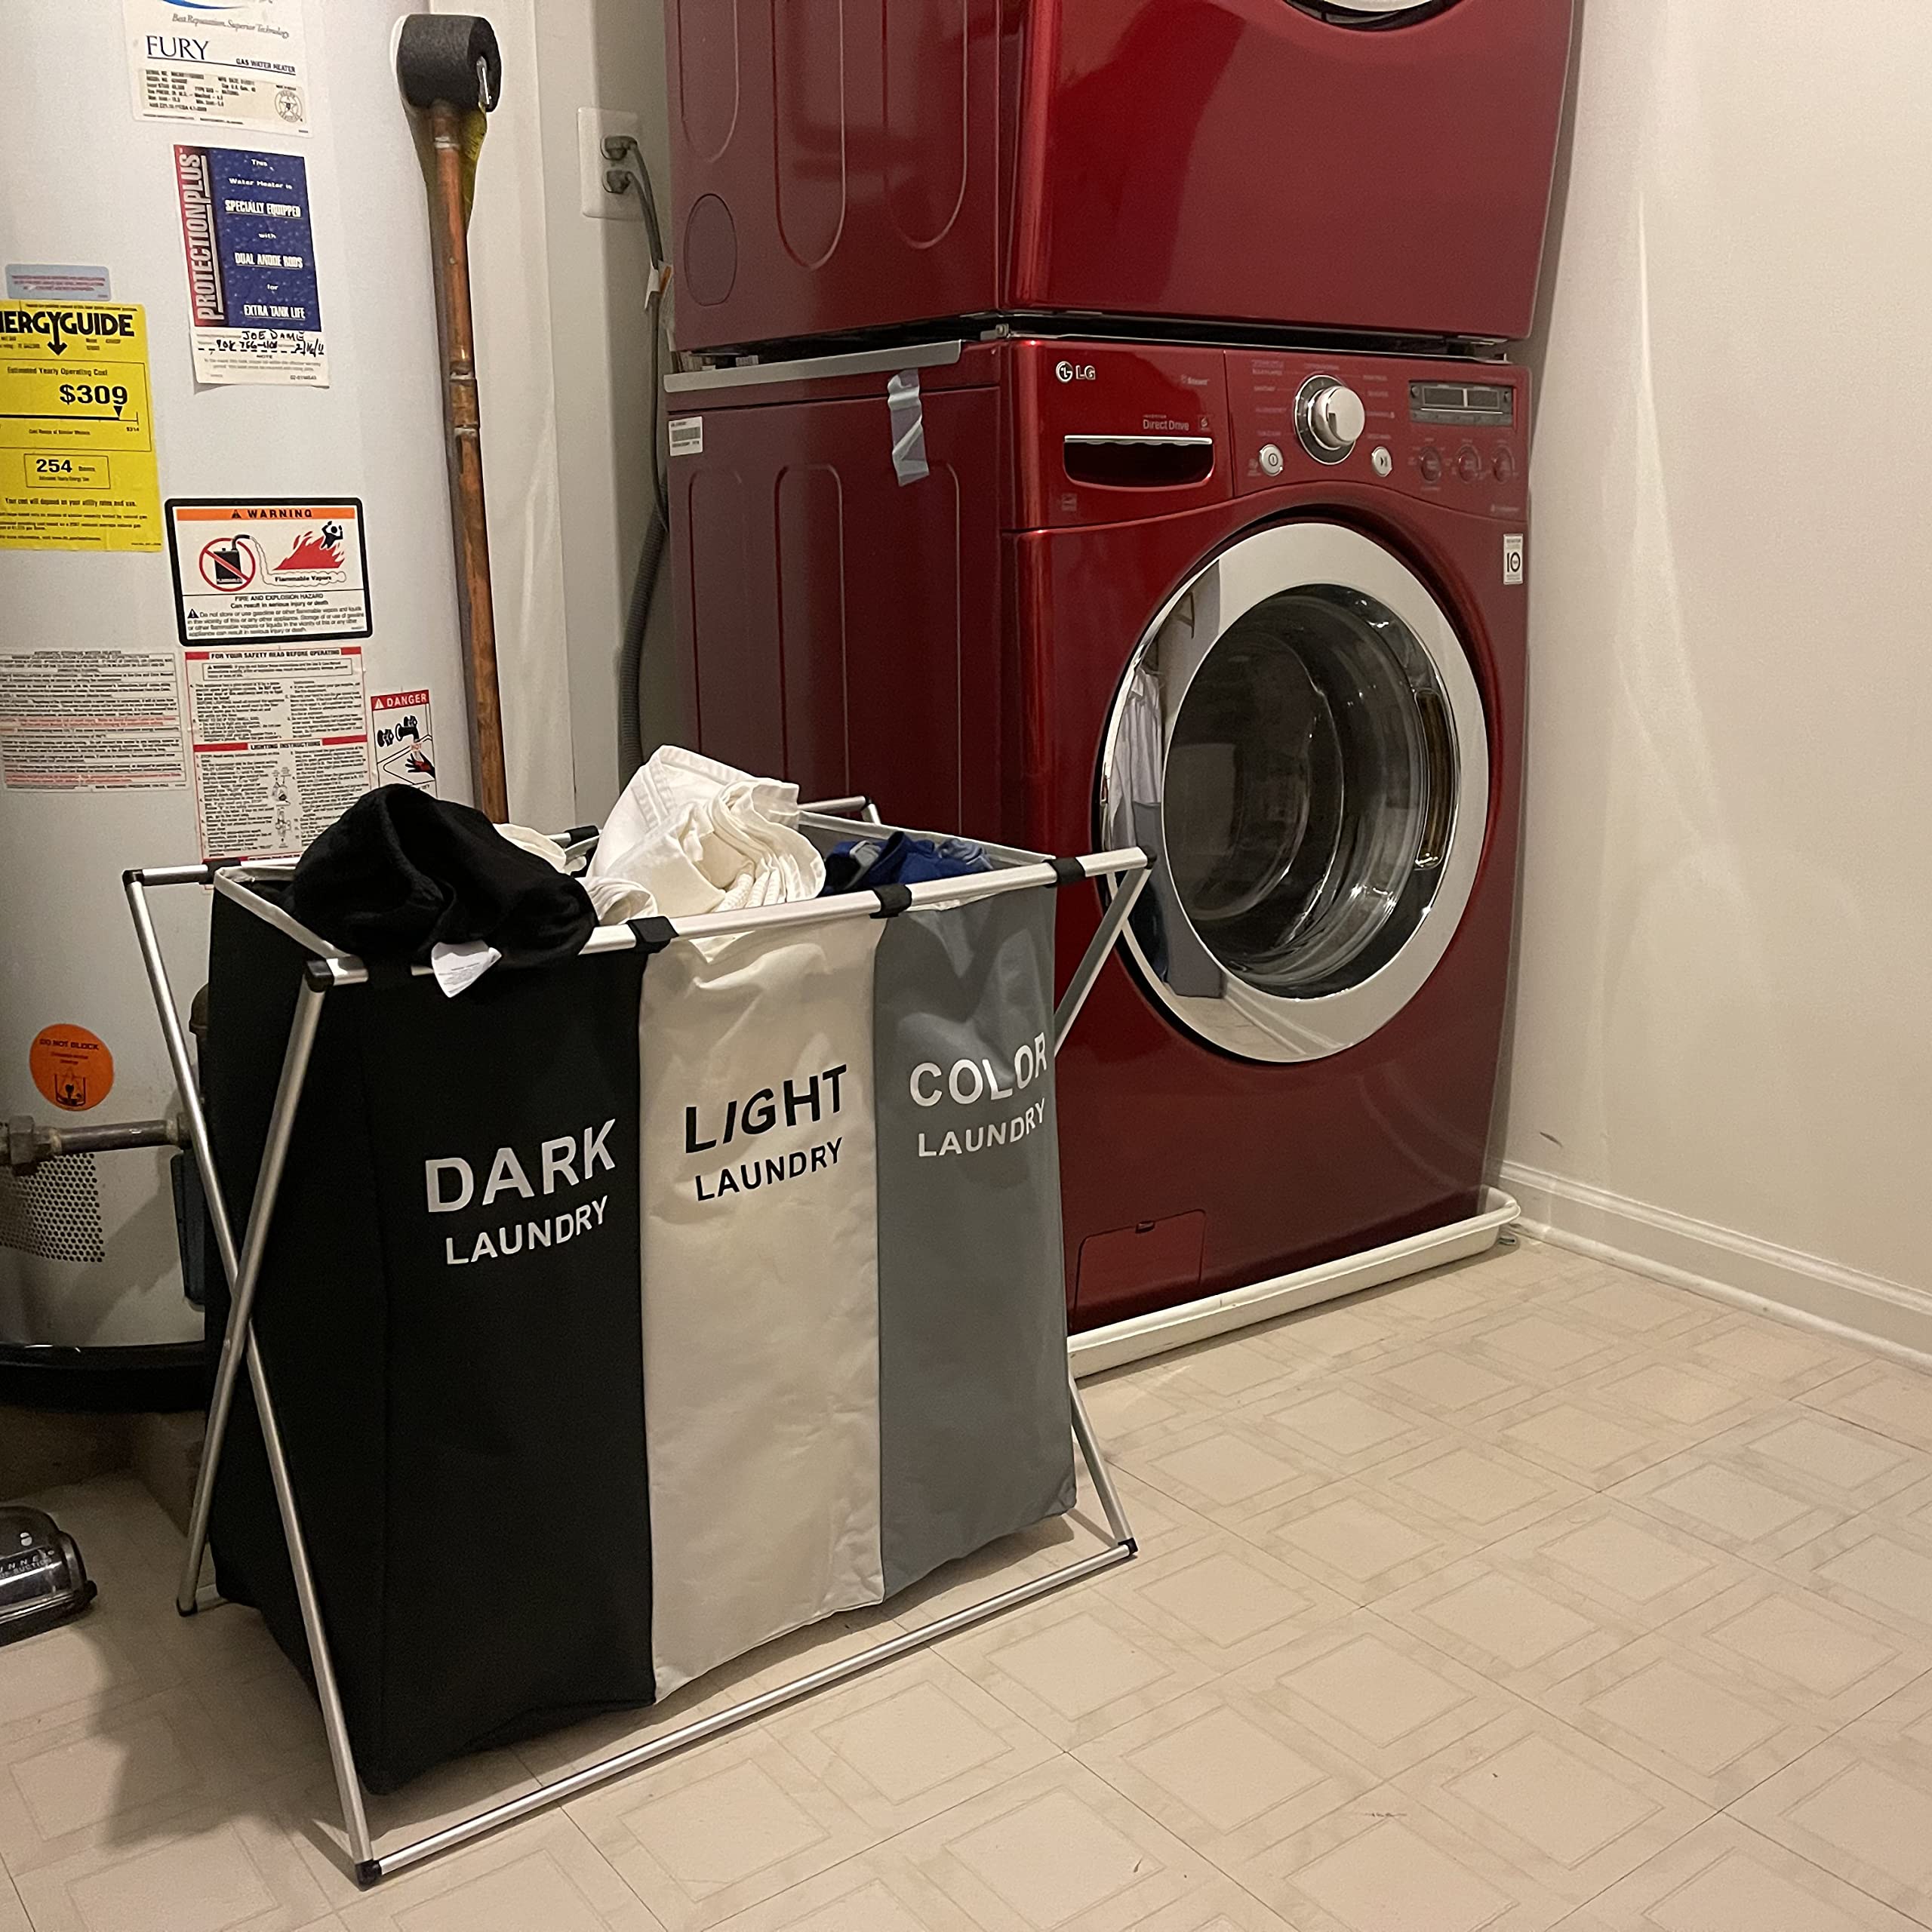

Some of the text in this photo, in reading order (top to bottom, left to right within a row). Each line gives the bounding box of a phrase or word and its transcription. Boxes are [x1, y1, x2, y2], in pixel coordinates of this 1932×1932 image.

[146, 35, 209, 60] FURY
[236, 58, 295, 73] GAS WATER HEATER
[229, 177, 254, 186] Water
[257, 180, 283, 189] Heater
[225, 199, 301, 217] SPECIALLY EQUIPPED
[258, 231, 276, 239] with
[235, 252, 303, 269] DUAL ANODE RODS
[244, 304, 305, 319] EXTRA TANK LIFE
[0, 310, 134, 337] ERGYGUIDE
[242, 330, 266, 340] JOE
[1075, 365, 1096, 380] LG
[60, 383, 128, 405] $309
[1143, 419, 1189, 431] Direct Drive
[35, 459, 72, 473] 254
[248, 509, 312, 519] WARNING
[386, 693, 427, 707] DANGER
[909, 1032, 1048, 1107] COLOR
[685, 1064, 847, 1154] LIGHT
[918, 1098, 1046, 1157] LAUNDRY
[425, 1118, 616, 1213] DARK
[695, 1137, 843, 1201] LAUNDRY
[446, 1195, 608, 1265] LAUNDRY
